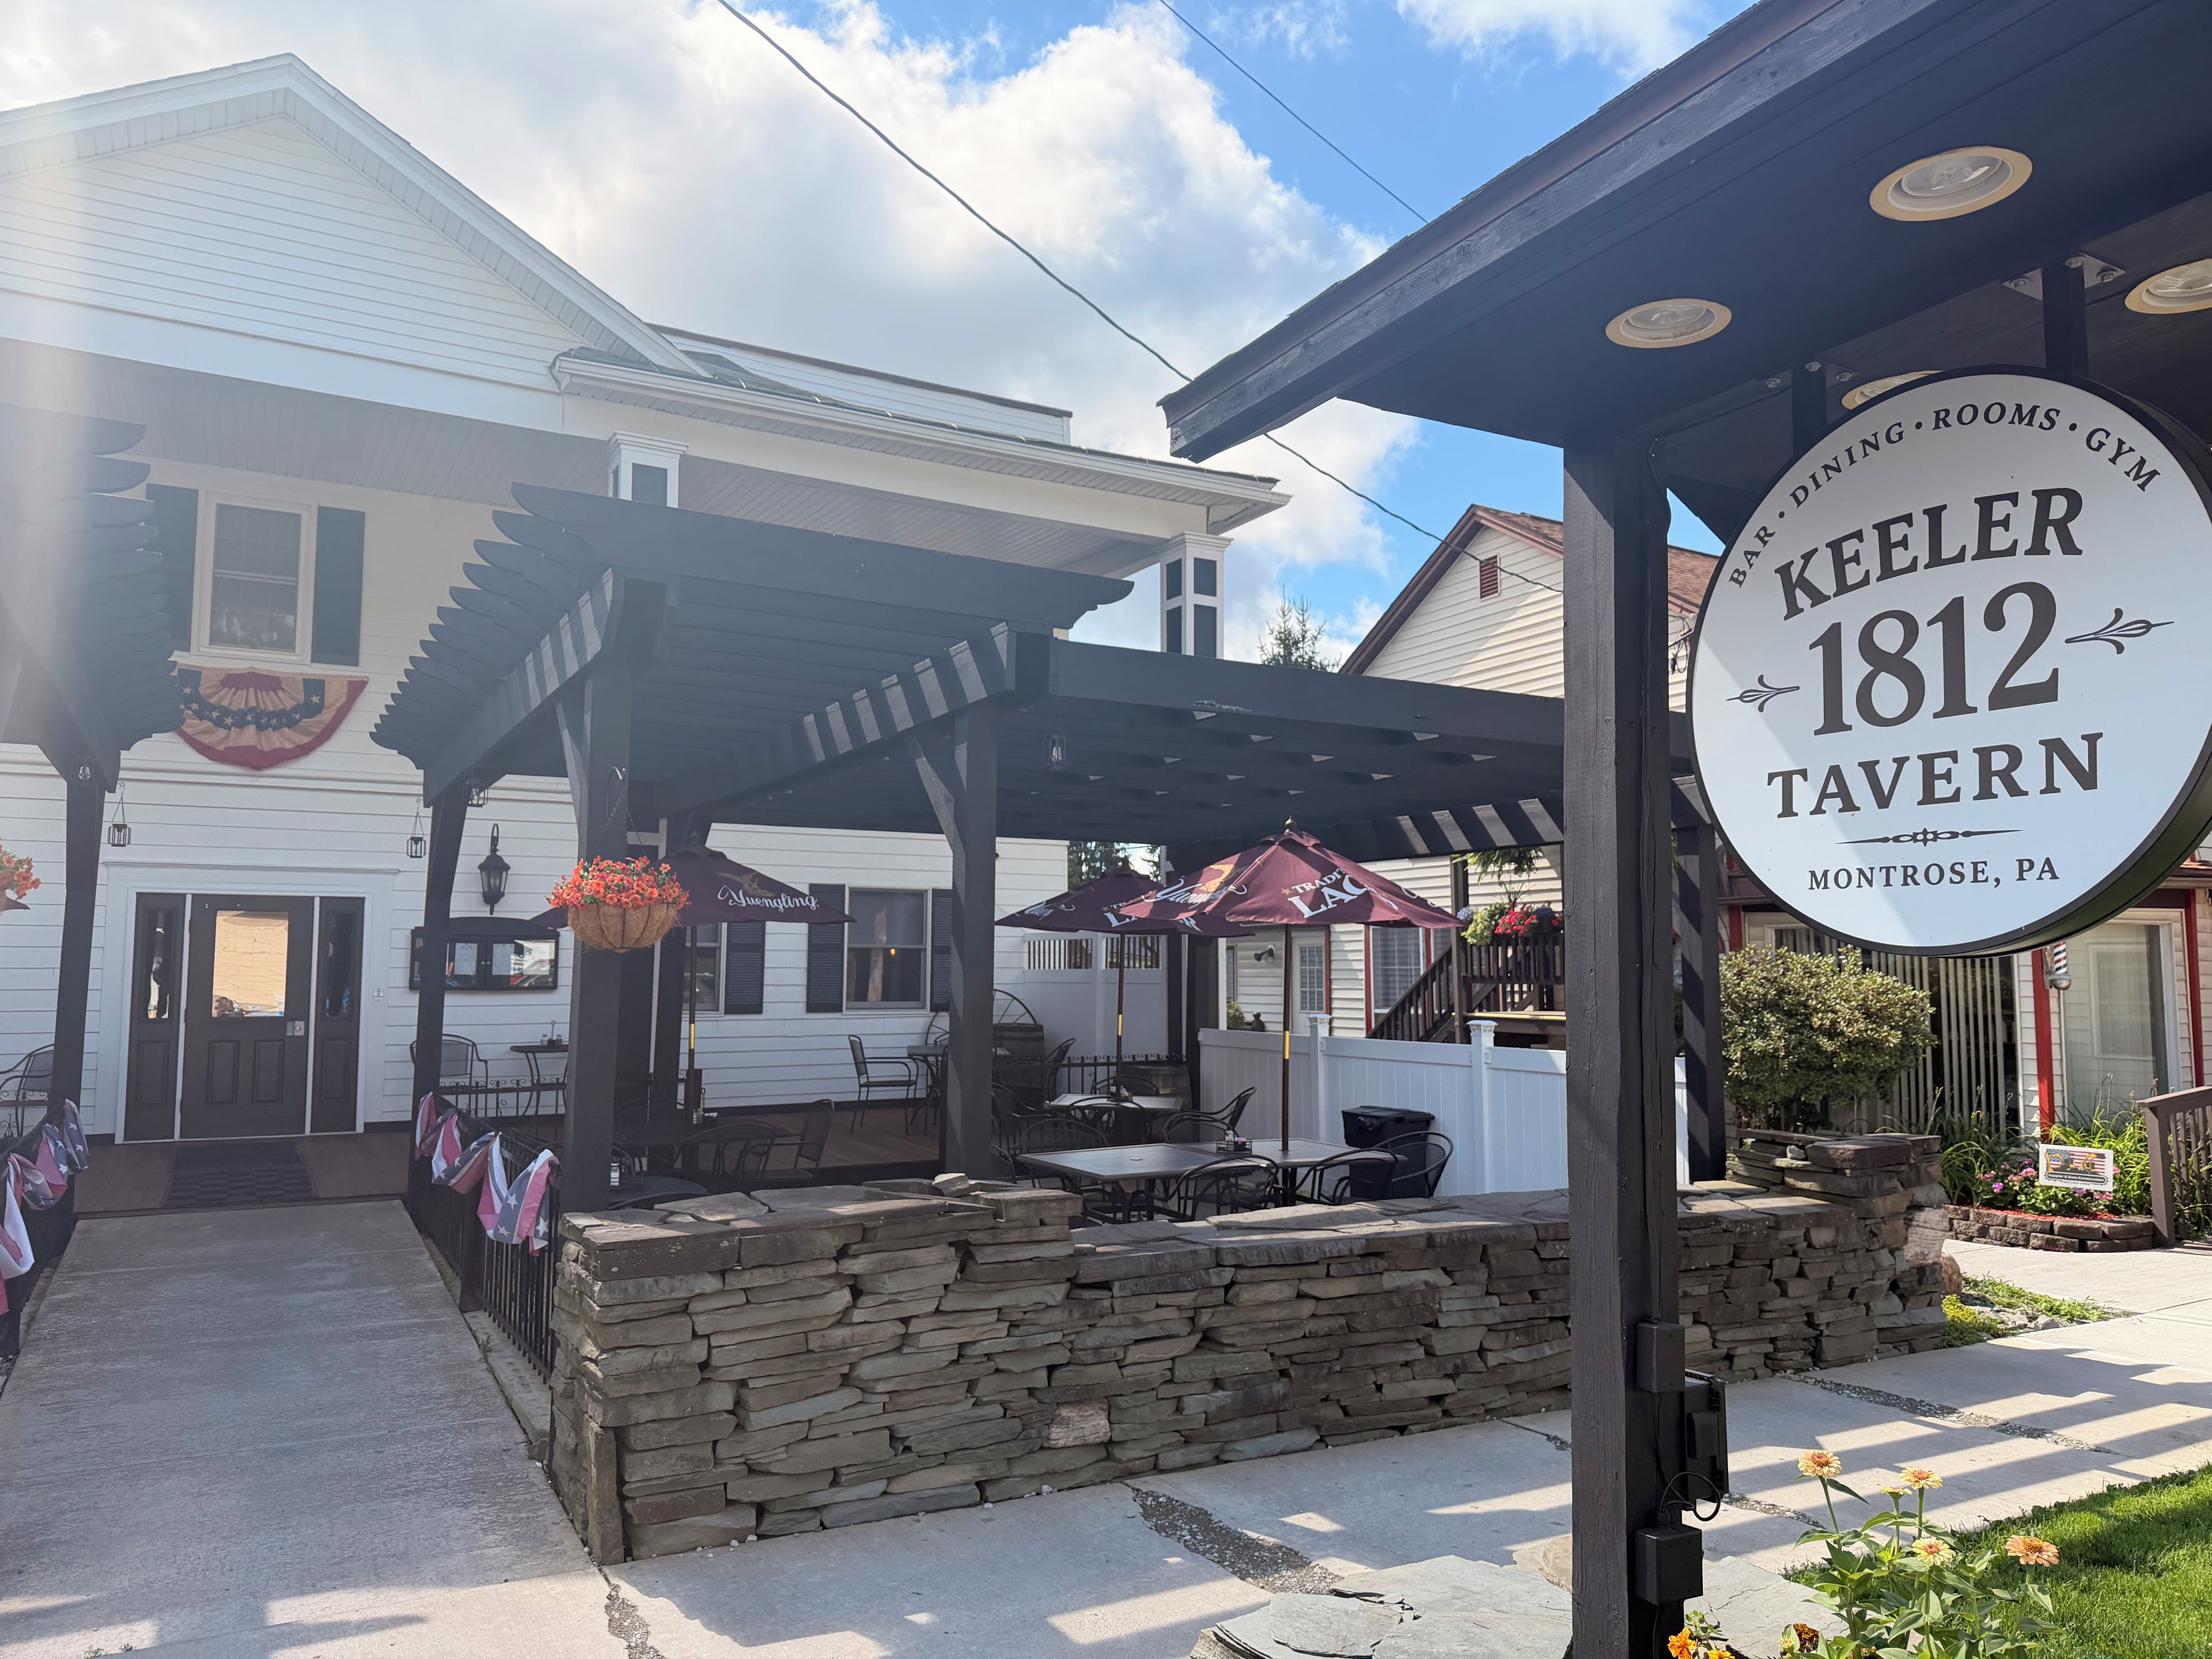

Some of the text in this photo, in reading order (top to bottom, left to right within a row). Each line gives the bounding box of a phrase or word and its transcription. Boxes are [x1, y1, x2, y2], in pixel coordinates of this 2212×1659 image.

[1728, 402, 2161, 589] BAR DINING ROOMS GYM
[1774, 487, 2083, 621] KEELER
[1809, 581, 2059, 736] 1812
[1767, 732, 2103, 819] TAVERN
[717, 884, 818, 913] Yuengling
[1808, 857, 2060, 890] MONTROSE, PA
